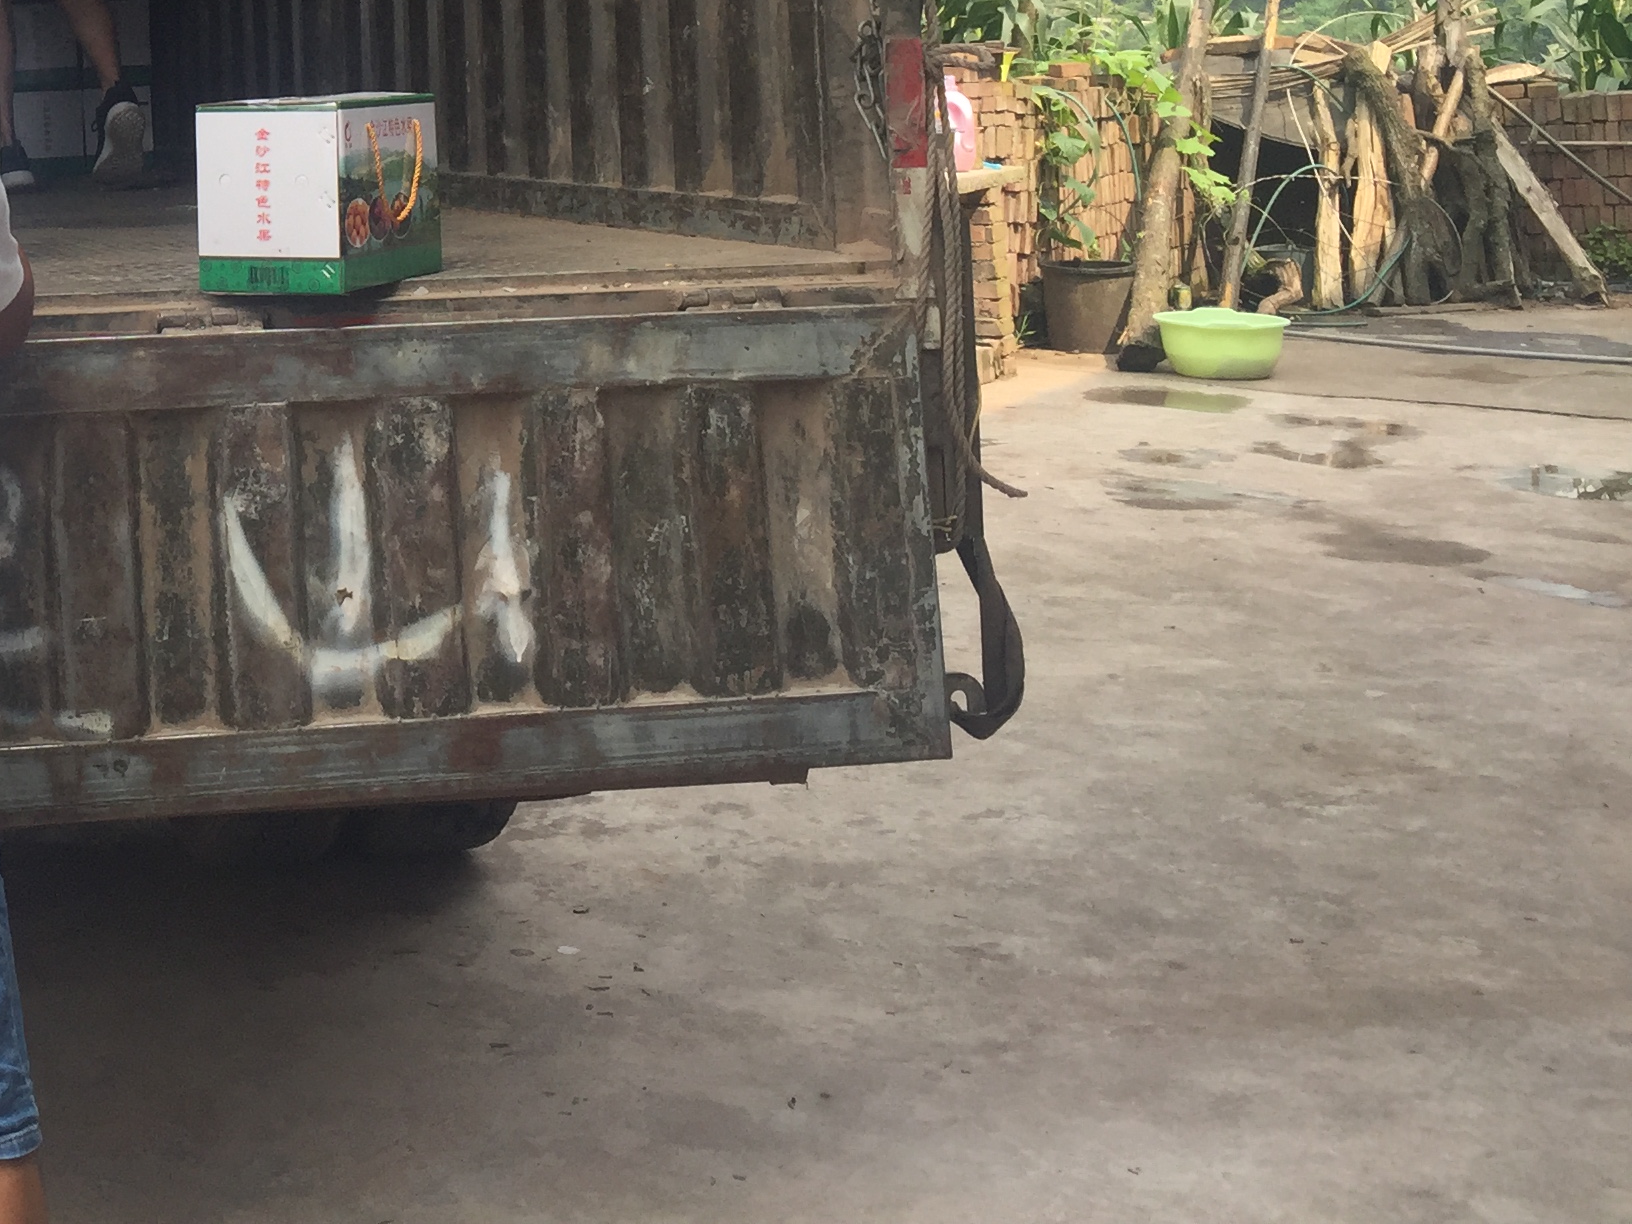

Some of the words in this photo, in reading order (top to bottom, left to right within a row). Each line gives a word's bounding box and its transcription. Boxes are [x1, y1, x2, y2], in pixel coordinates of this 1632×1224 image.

[254, 128, 272, 241] 金沙江特色水果
